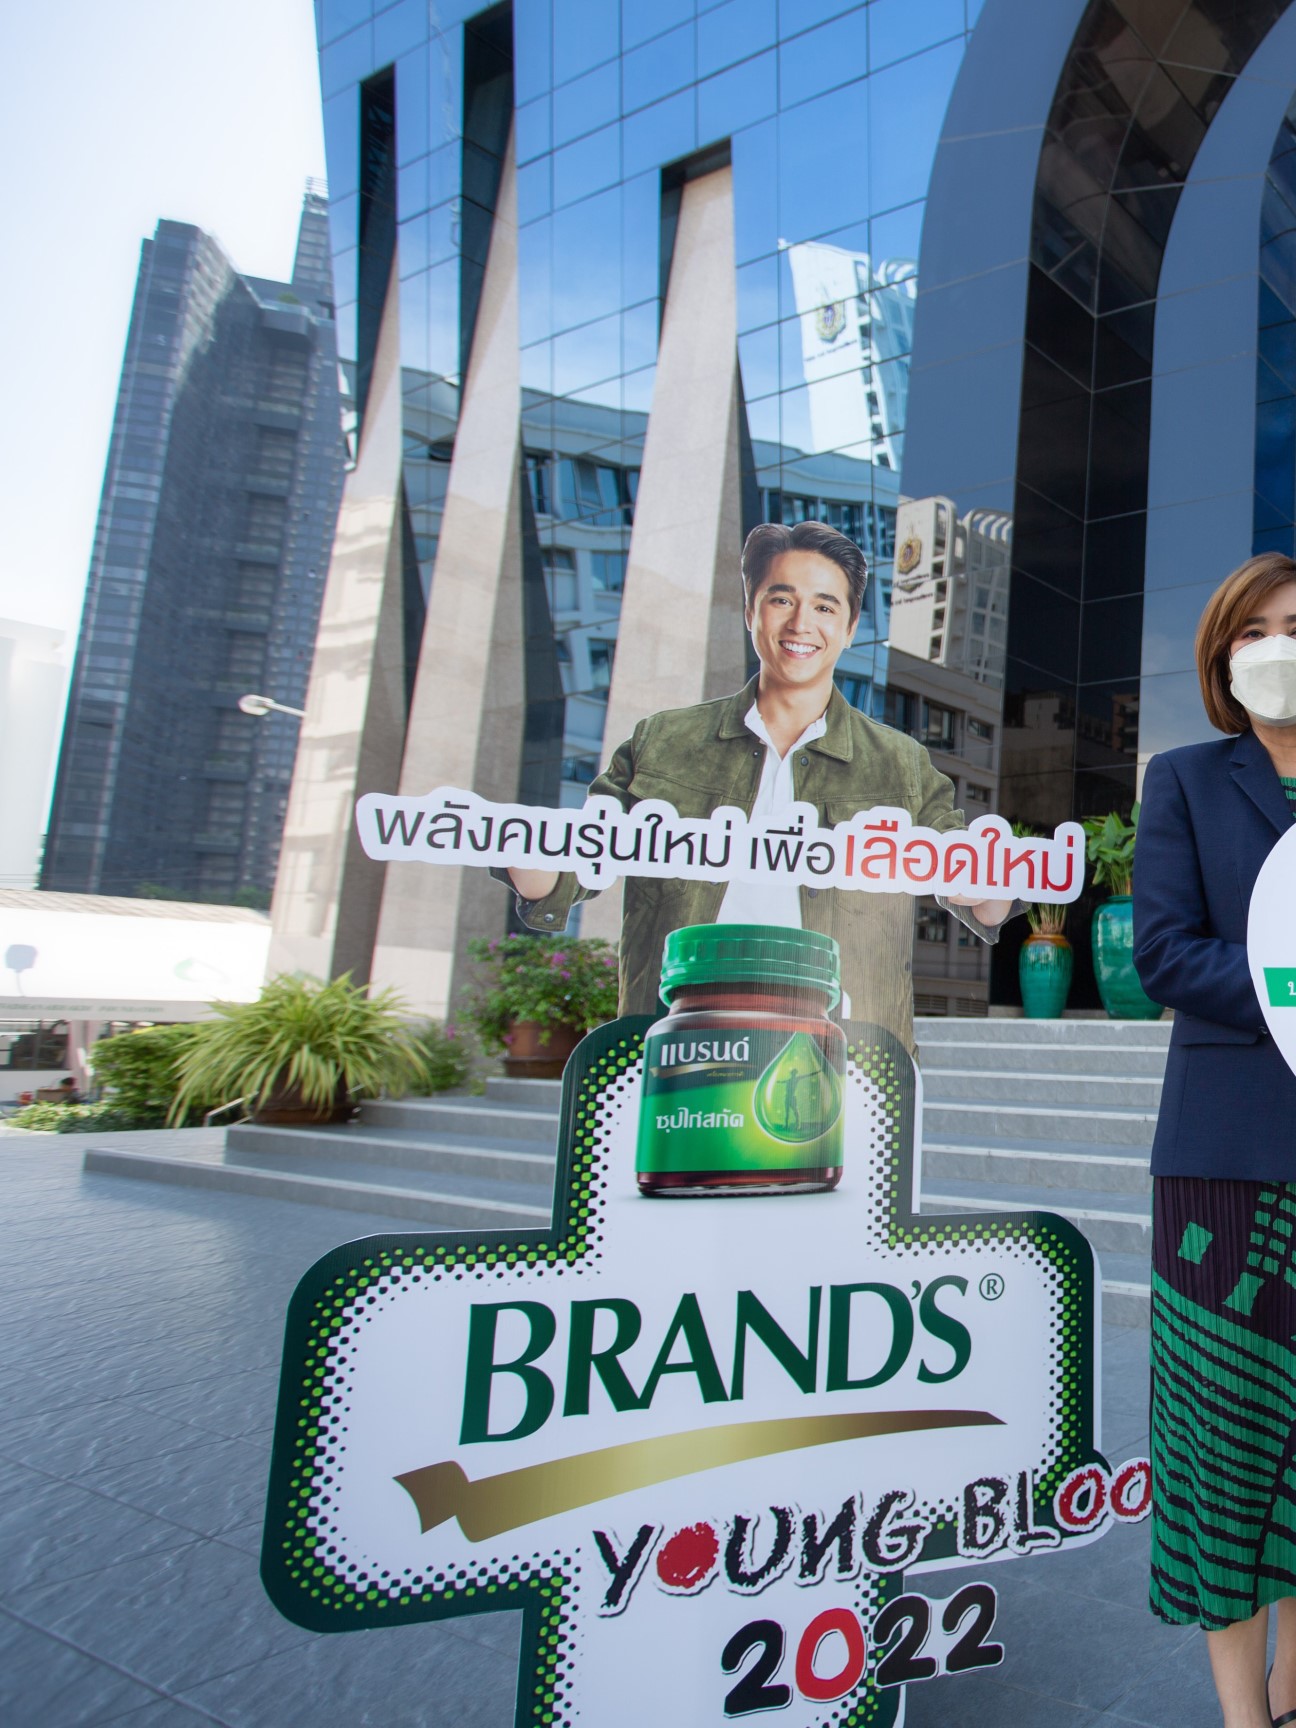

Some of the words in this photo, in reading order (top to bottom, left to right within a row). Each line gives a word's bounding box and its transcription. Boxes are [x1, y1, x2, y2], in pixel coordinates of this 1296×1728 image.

[375, 803, 731, 877] พลังคนรุ่นใหม่
[660, 1036, 750, 1066] แบรนด์
[656, 1107, 744, 1133] ซุปไก่สกัด
[459, 1274, 973, 1446] BRAND'S
[592, 1491, 926, 1609] YOUNG
[962, 1460, 1152, 1553] BLOO
[720, 1584, 1004, 1716] 2022
